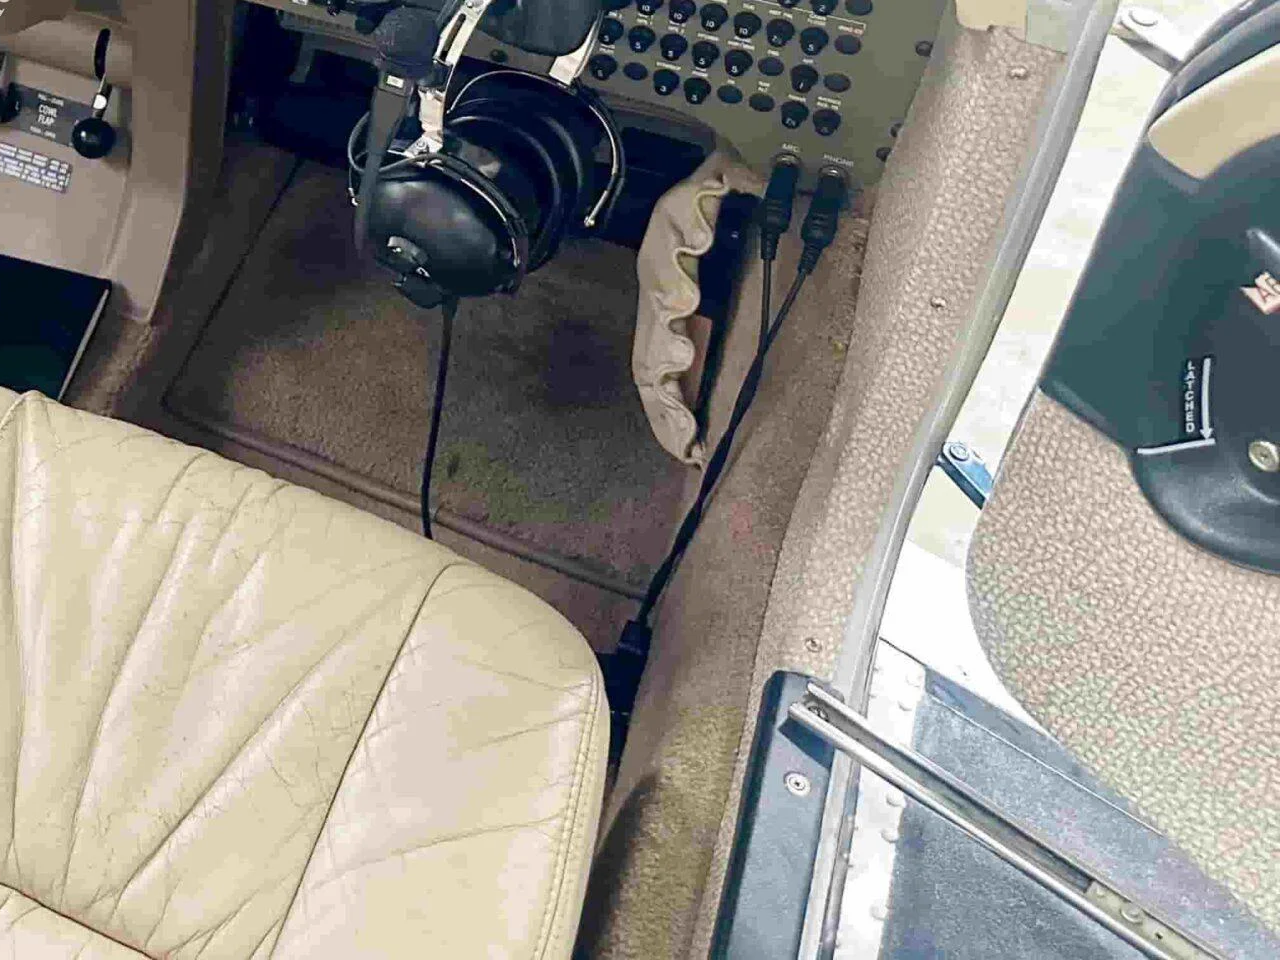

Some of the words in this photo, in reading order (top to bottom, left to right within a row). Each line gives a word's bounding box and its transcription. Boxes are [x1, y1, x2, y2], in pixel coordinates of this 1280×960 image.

[641, 4, 650, 12] 10
[819, 4, 826, 13] 2
[673, 12, 683, 21] 10
[705, 20, 715, 29] 10
[739, 28, 749, 36] 10
[39, 104, 57, 117] COWL
[38, 114, 55, 126] FLAP
[1184, 359, 1196, 434] LATCHED
